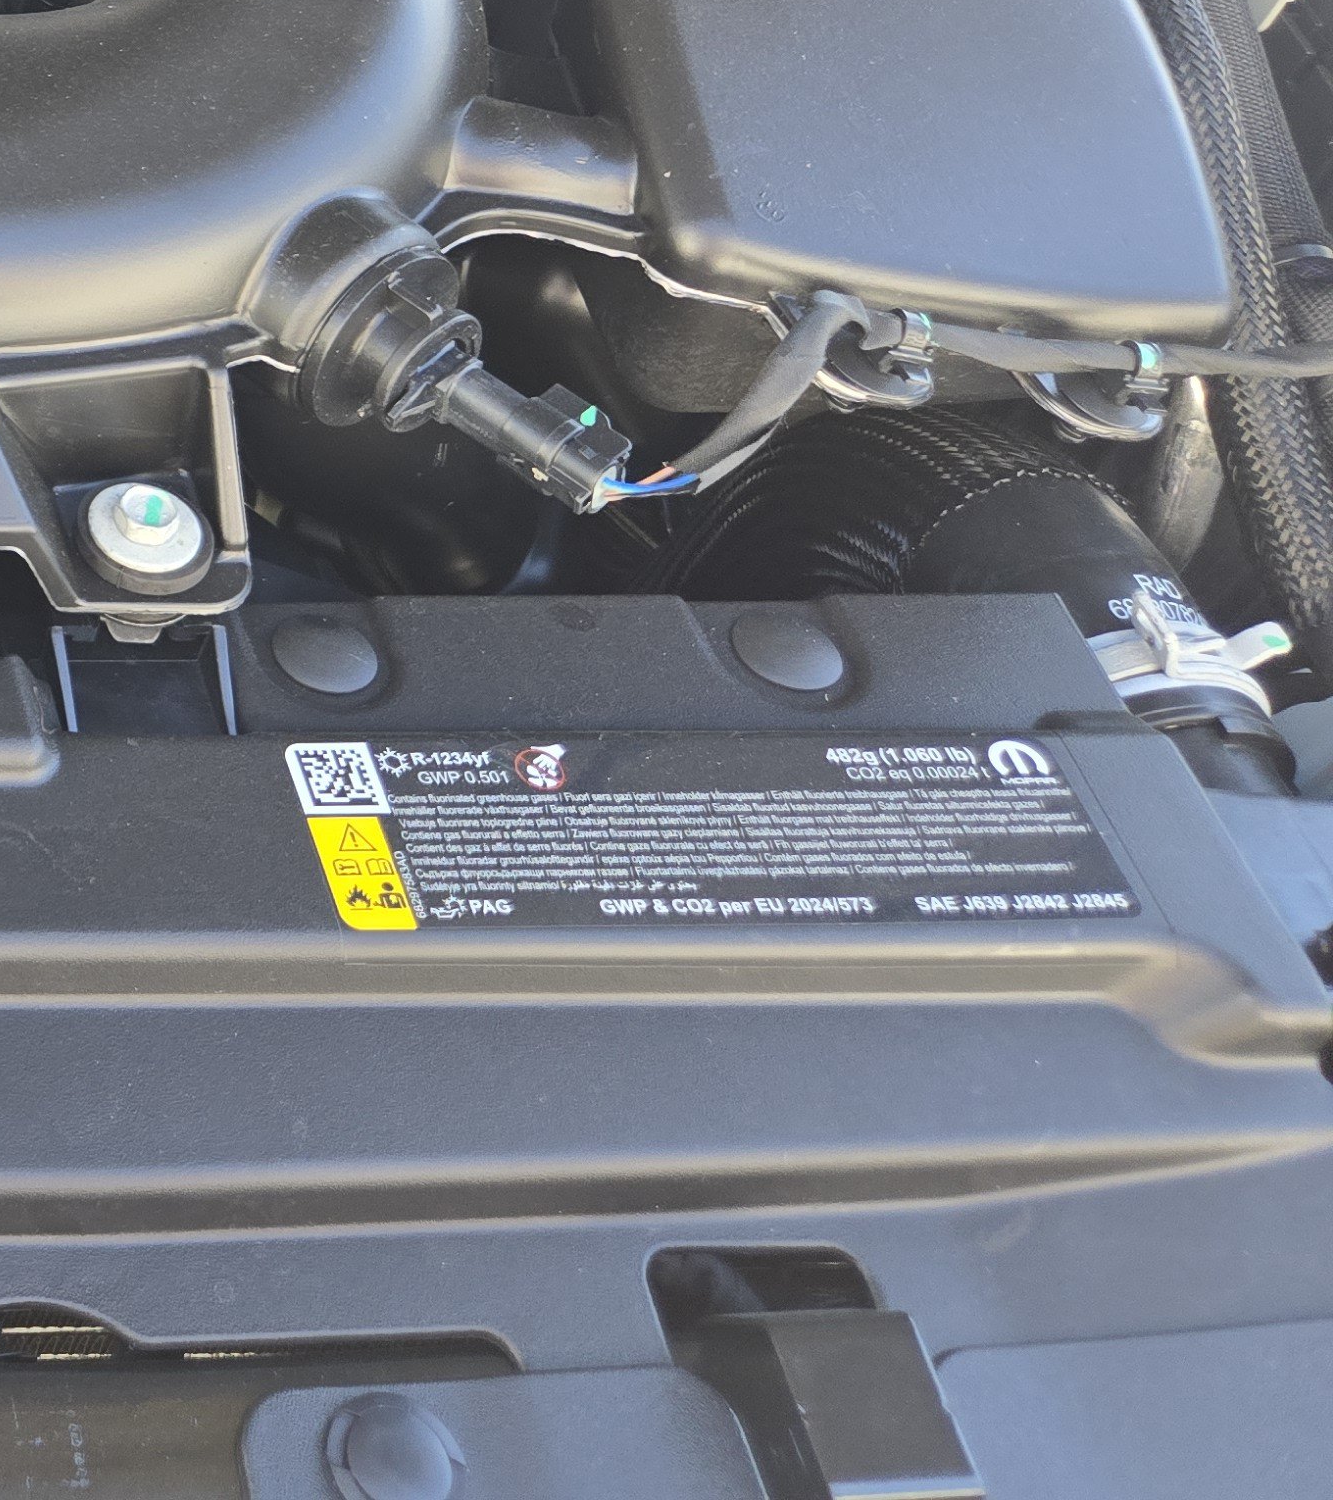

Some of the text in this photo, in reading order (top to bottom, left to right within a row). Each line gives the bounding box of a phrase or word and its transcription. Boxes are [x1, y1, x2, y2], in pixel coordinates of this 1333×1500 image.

[1133, 573, 1182, 600] RAD
[410, 750, 492, 768] R-1234yf
[826, 746, 977, 766] 482g (1.060 lb)
[417, 770, 510, 785] GWP 0.501
[846, 765, 992, 783] CO2 eq 0.00024 t
[1000, 776, 1057, 786] MOPAR
[388, 794, 427, 803] Contains
[428, 793, 475, 804] fluorinated
[476, 793, 530, 805] greenhouse
[531, 794, 559, 804] gases
[444, 831, 462, 841] gas
[445, 842, 464, 852] des
[513, 842, 525, 852] de
[393, 849, 429, 920] 68297583AD
[468, 898, 513, 914] PAG
[599, 897, 874, 917] GWP & CO2 per EU 2024/573
[914, 893, 1130, 912] SAE J639 J2842 J2845
